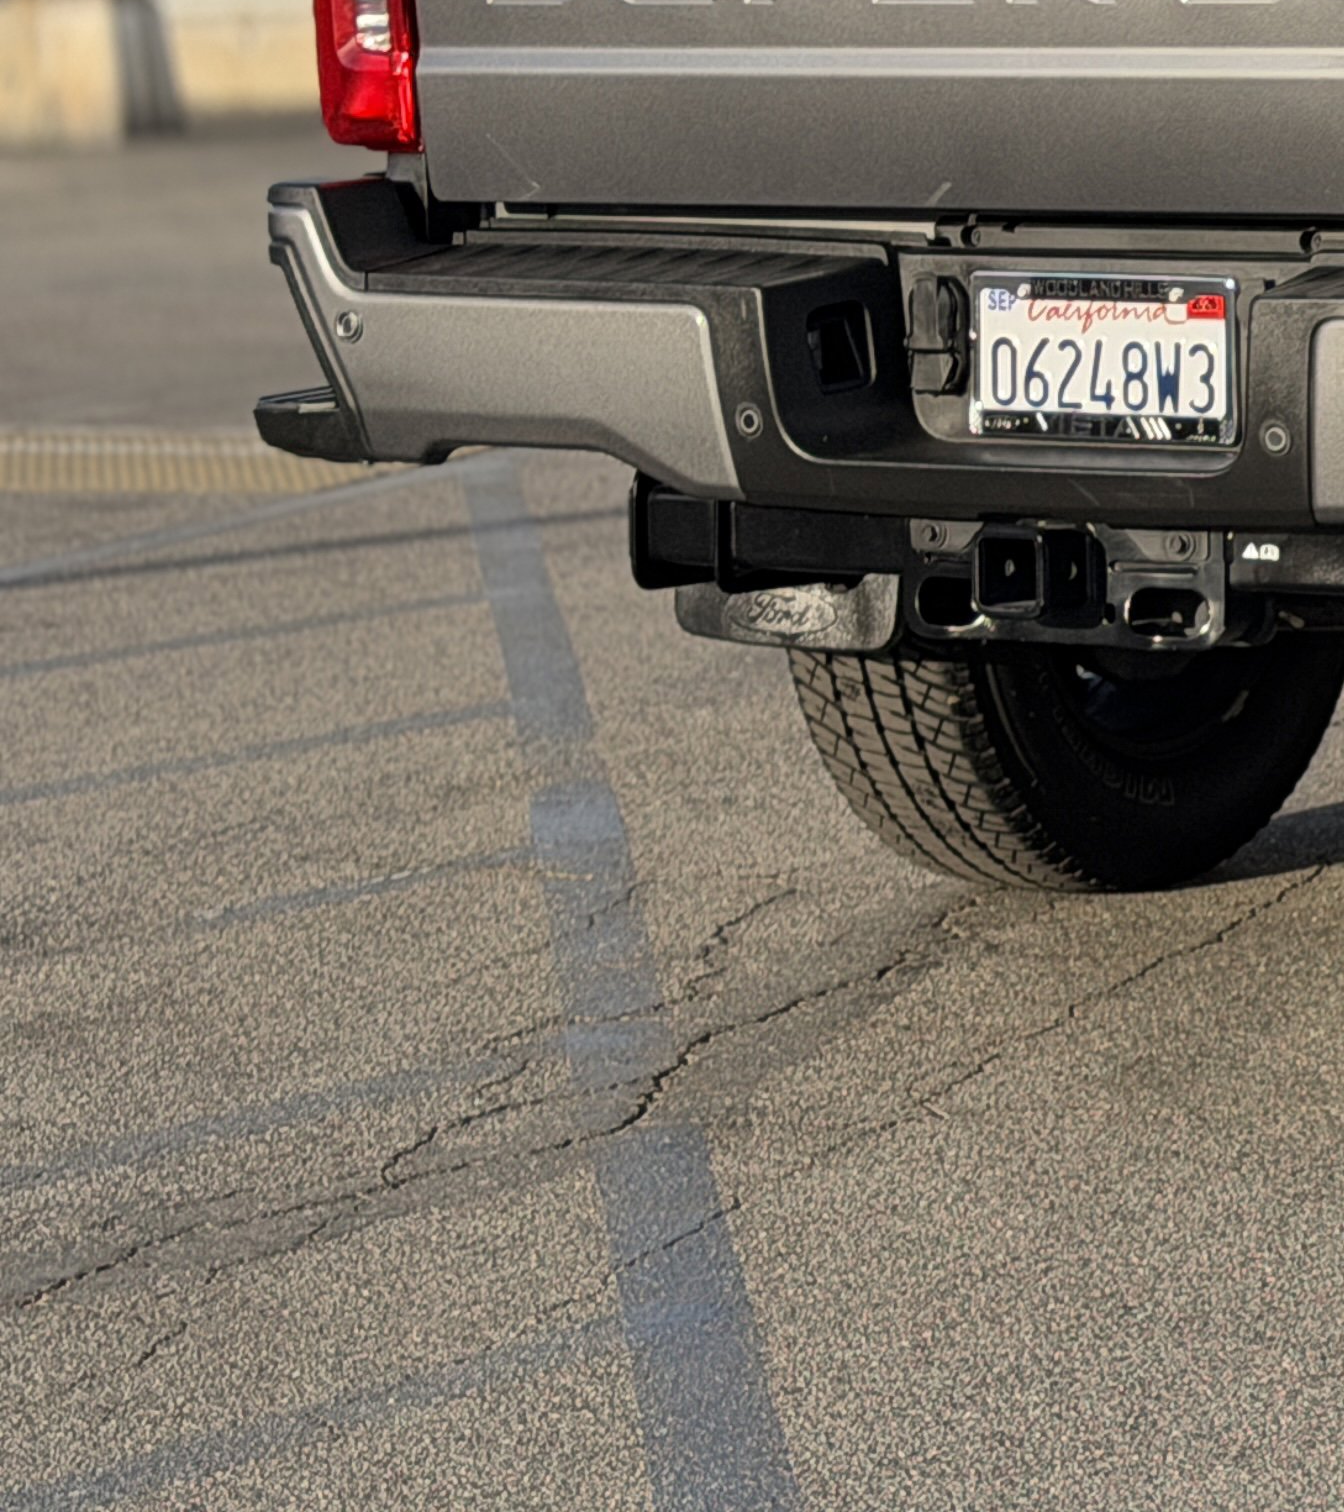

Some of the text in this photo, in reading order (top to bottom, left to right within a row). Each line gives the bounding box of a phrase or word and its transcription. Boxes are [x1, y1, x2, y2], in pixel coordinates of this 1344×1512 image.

[988, 289, 1017, 312] SEP
[1032, 279, 1121, 298] WOODLAND
[1027, 299, 1188, 335] California
[991, 336, 1216, 414] 06248W3
[747, 592, 812, 627] Ford
